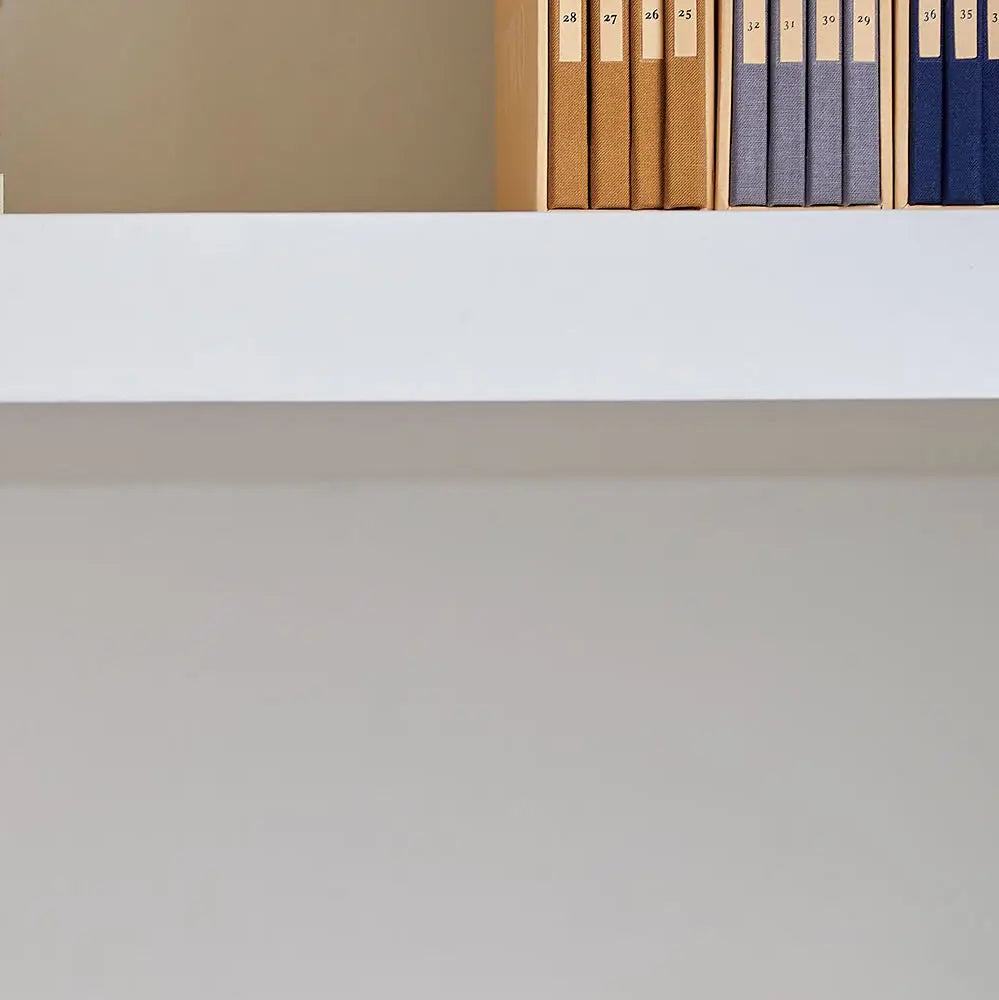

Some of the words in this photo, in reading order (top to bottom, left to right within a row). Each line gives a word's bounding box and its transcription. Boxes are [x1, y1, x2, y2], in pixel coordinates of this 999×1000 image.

[563, 12, 577, 23] 28
[604, 14, 618, 25] 27
[645, 9, 659, 20] 26
[678, 9, 692, 20] 25
[923, 9, 937, 22] 36
[960, 9, 973, 20] 35
[992, 13, 999, 23] 3
[783, 20, 795, 31] 31
[822, 15, 836, 26] 30
[857, 15, 871, 26] 29
[747, 21, 760, 32] 32
